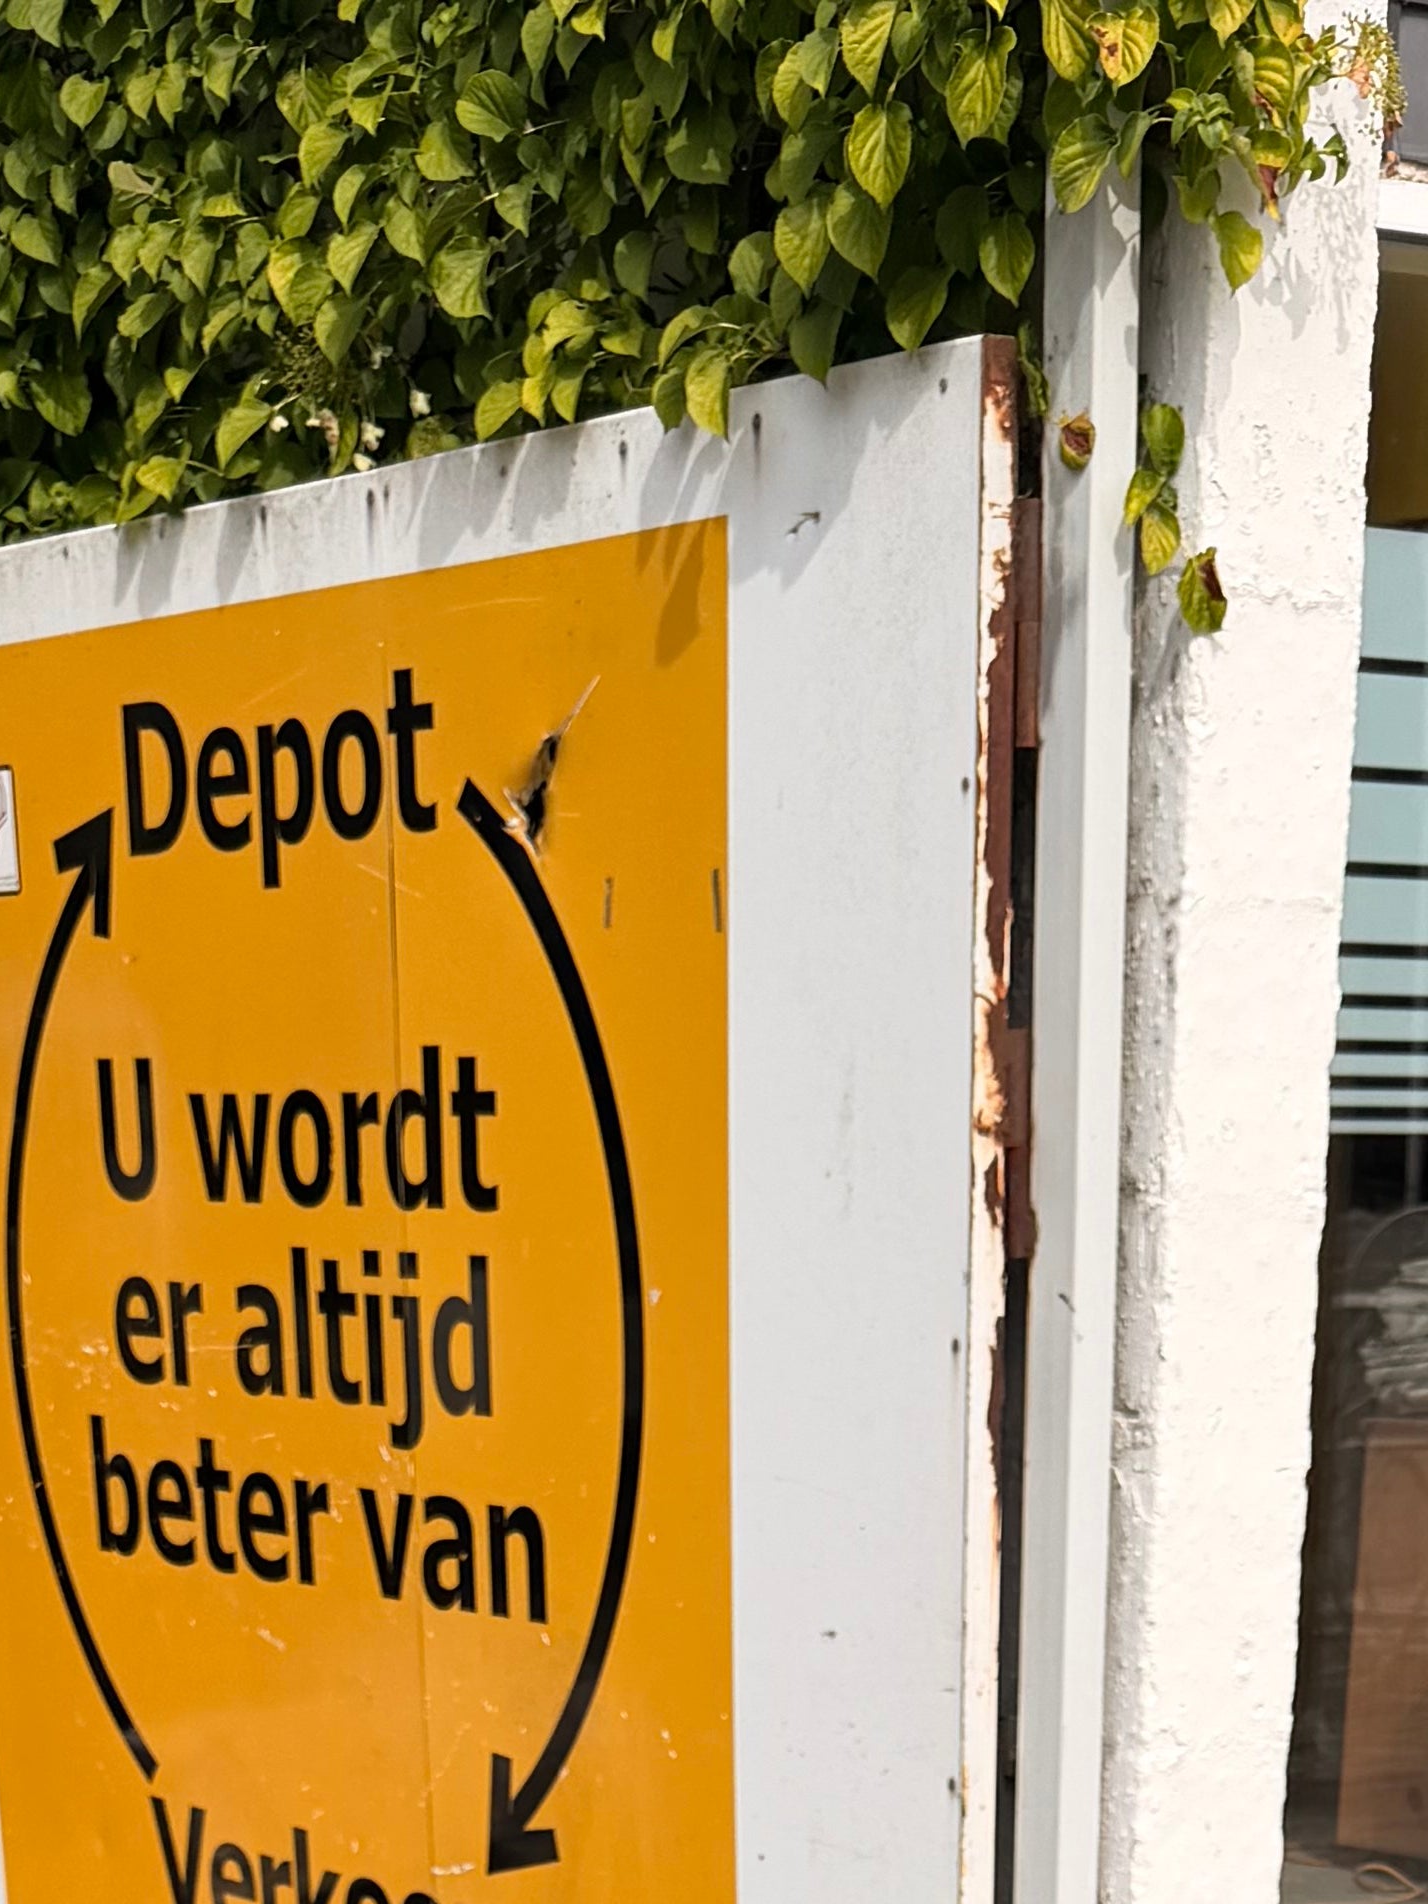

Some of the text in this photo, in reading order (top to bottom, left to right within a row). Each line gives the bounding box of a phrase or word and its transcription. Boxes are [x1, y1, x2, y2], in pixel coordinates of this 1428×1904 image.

[123, 669, 436, 888] Depot
[98, 1046, 497, 1211] U wordt
[116, 1247, 490, 1450] er altijd
[91, 1415, 546, 1623] beter van
